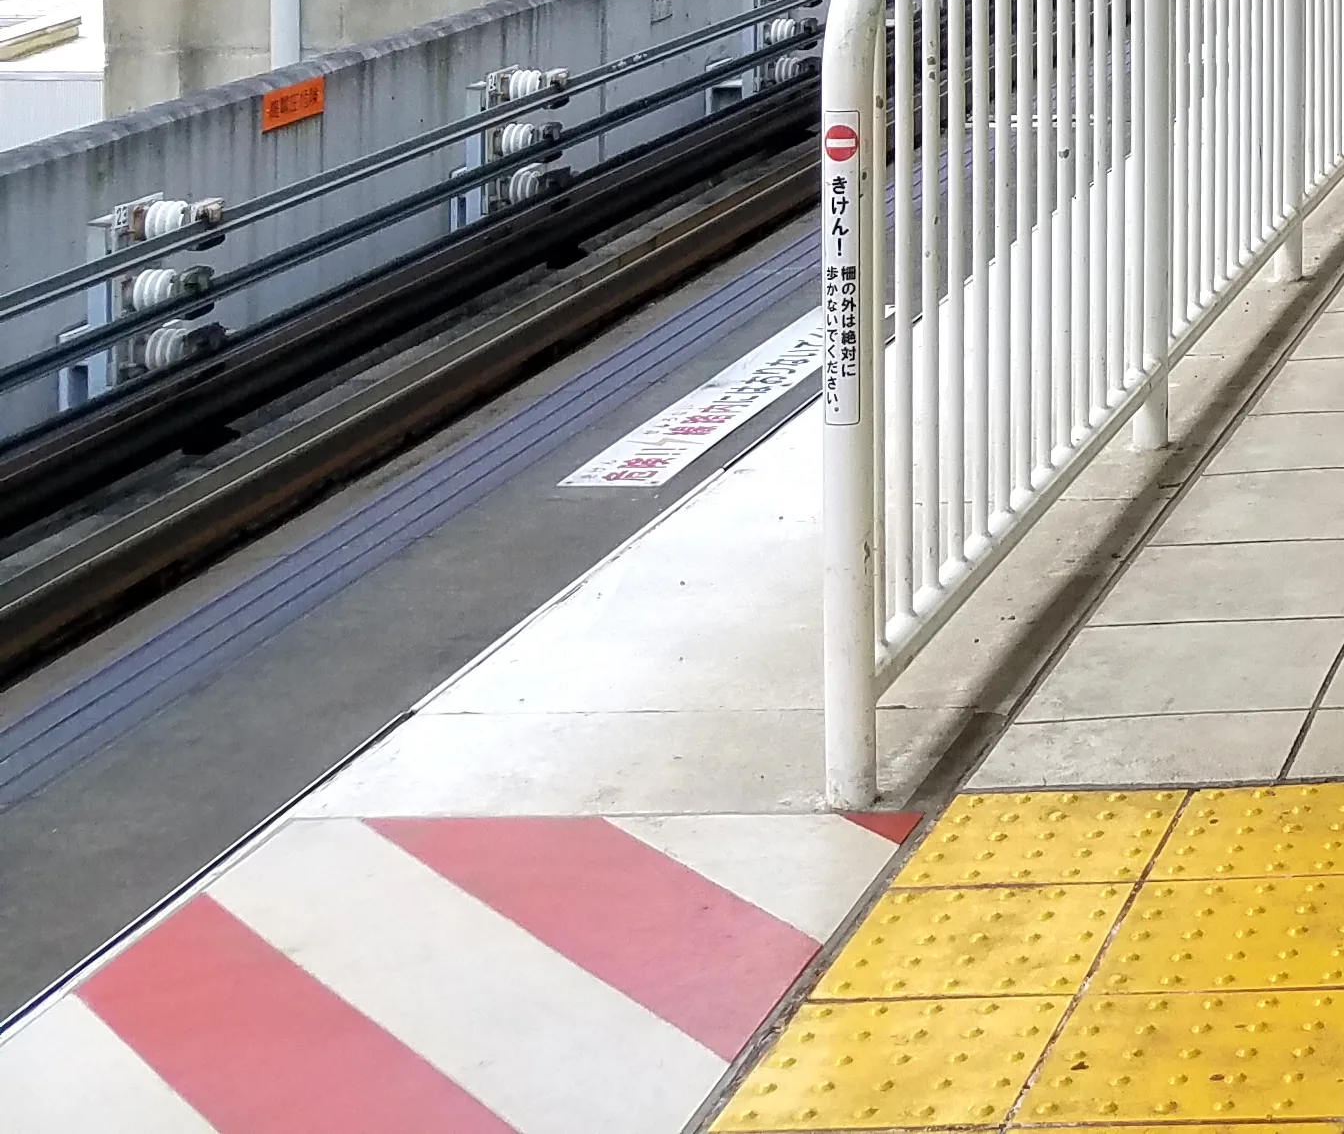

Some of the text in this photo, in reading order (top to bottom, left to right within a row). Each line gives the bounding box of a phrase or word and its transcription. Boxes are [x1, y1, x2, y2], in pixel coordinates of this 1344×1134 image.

[831, 176, 850, 256] きけん!
[826, 266, 838, 412] 歩かないでください。
[841, 265, 857, 377] 柵の外は絶対に
